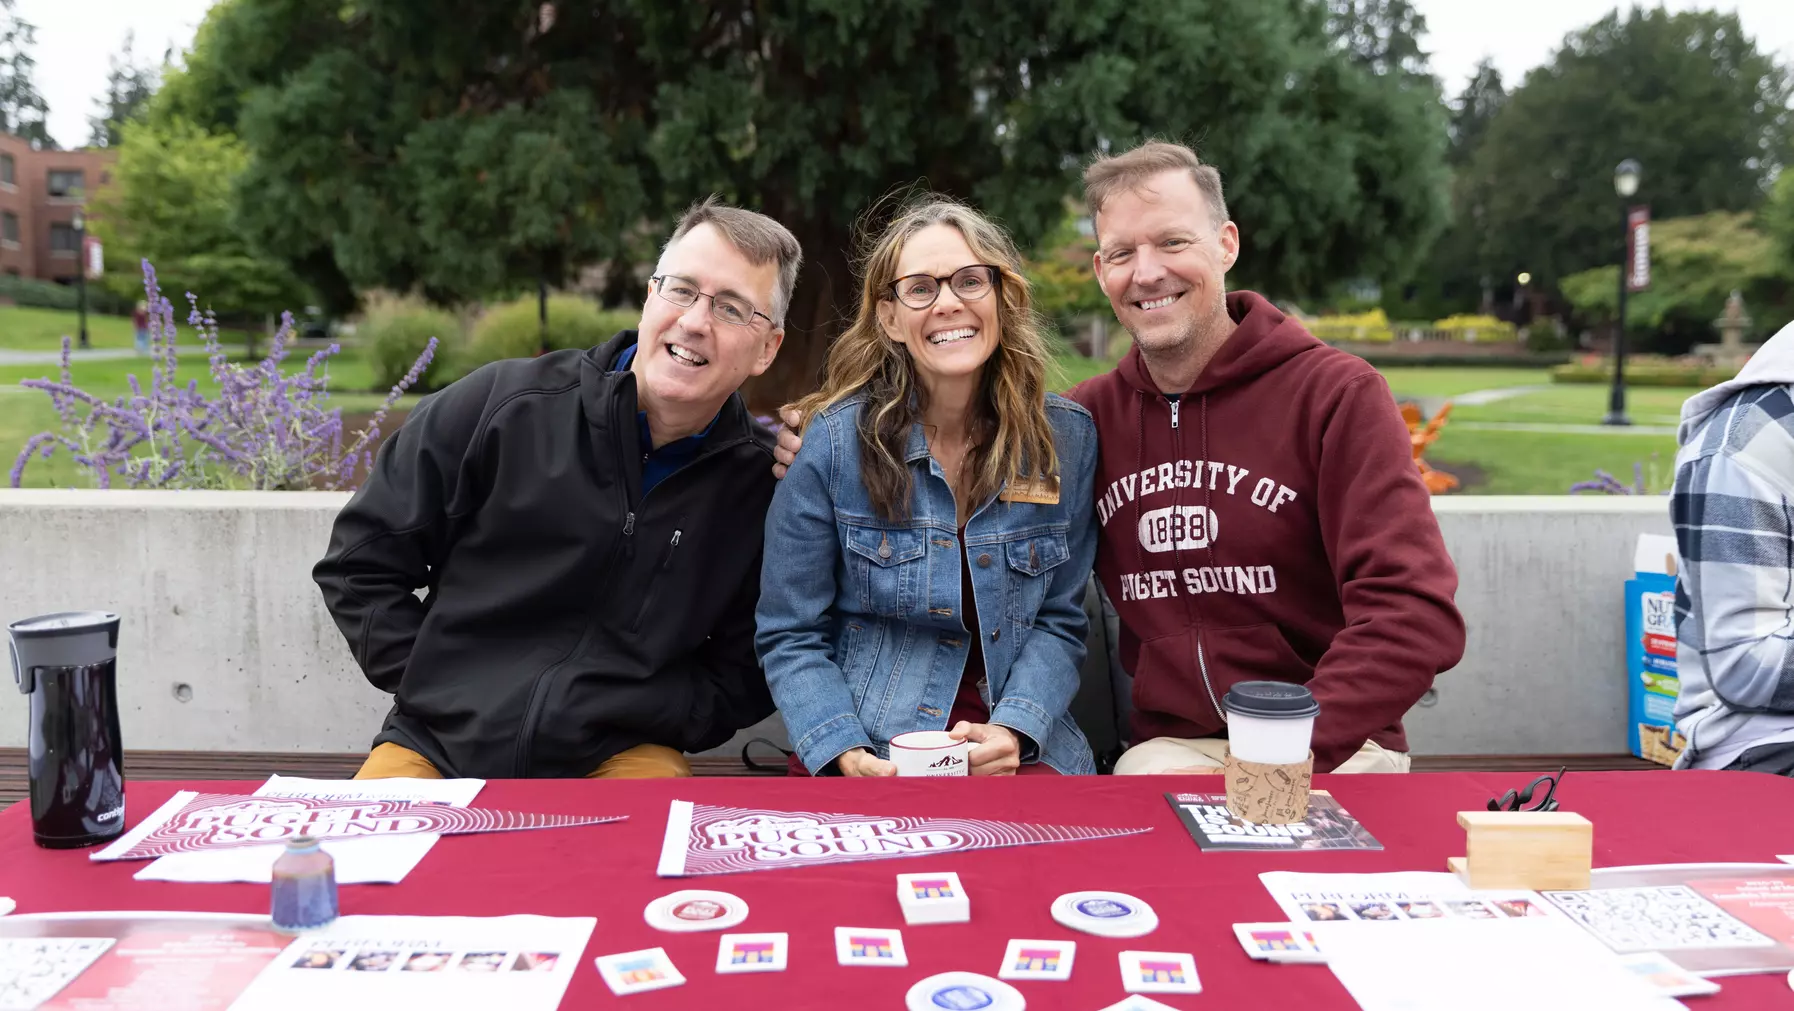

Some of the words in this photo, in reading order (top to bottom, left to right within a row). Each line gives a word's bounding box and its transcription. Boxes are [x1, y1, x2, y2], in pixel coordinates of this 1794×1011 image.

[1096, 460, 1249, 527] UNIVERSITY
[1250, 477, 1297, 513] OF
[1148, 513, 1205, 546] 1888
[1120, 569, 1178, 601] PUGET
[1182, 564, 1277, 595] SOUND
[183, 807, 377, 833] PUGET
[216, 816, 430, 842] SOUND
[1200, 823, 1313, 837] SOUND
[712, 821, 898, 849] PUGET
[755, 833, 961, 859] SOUND
